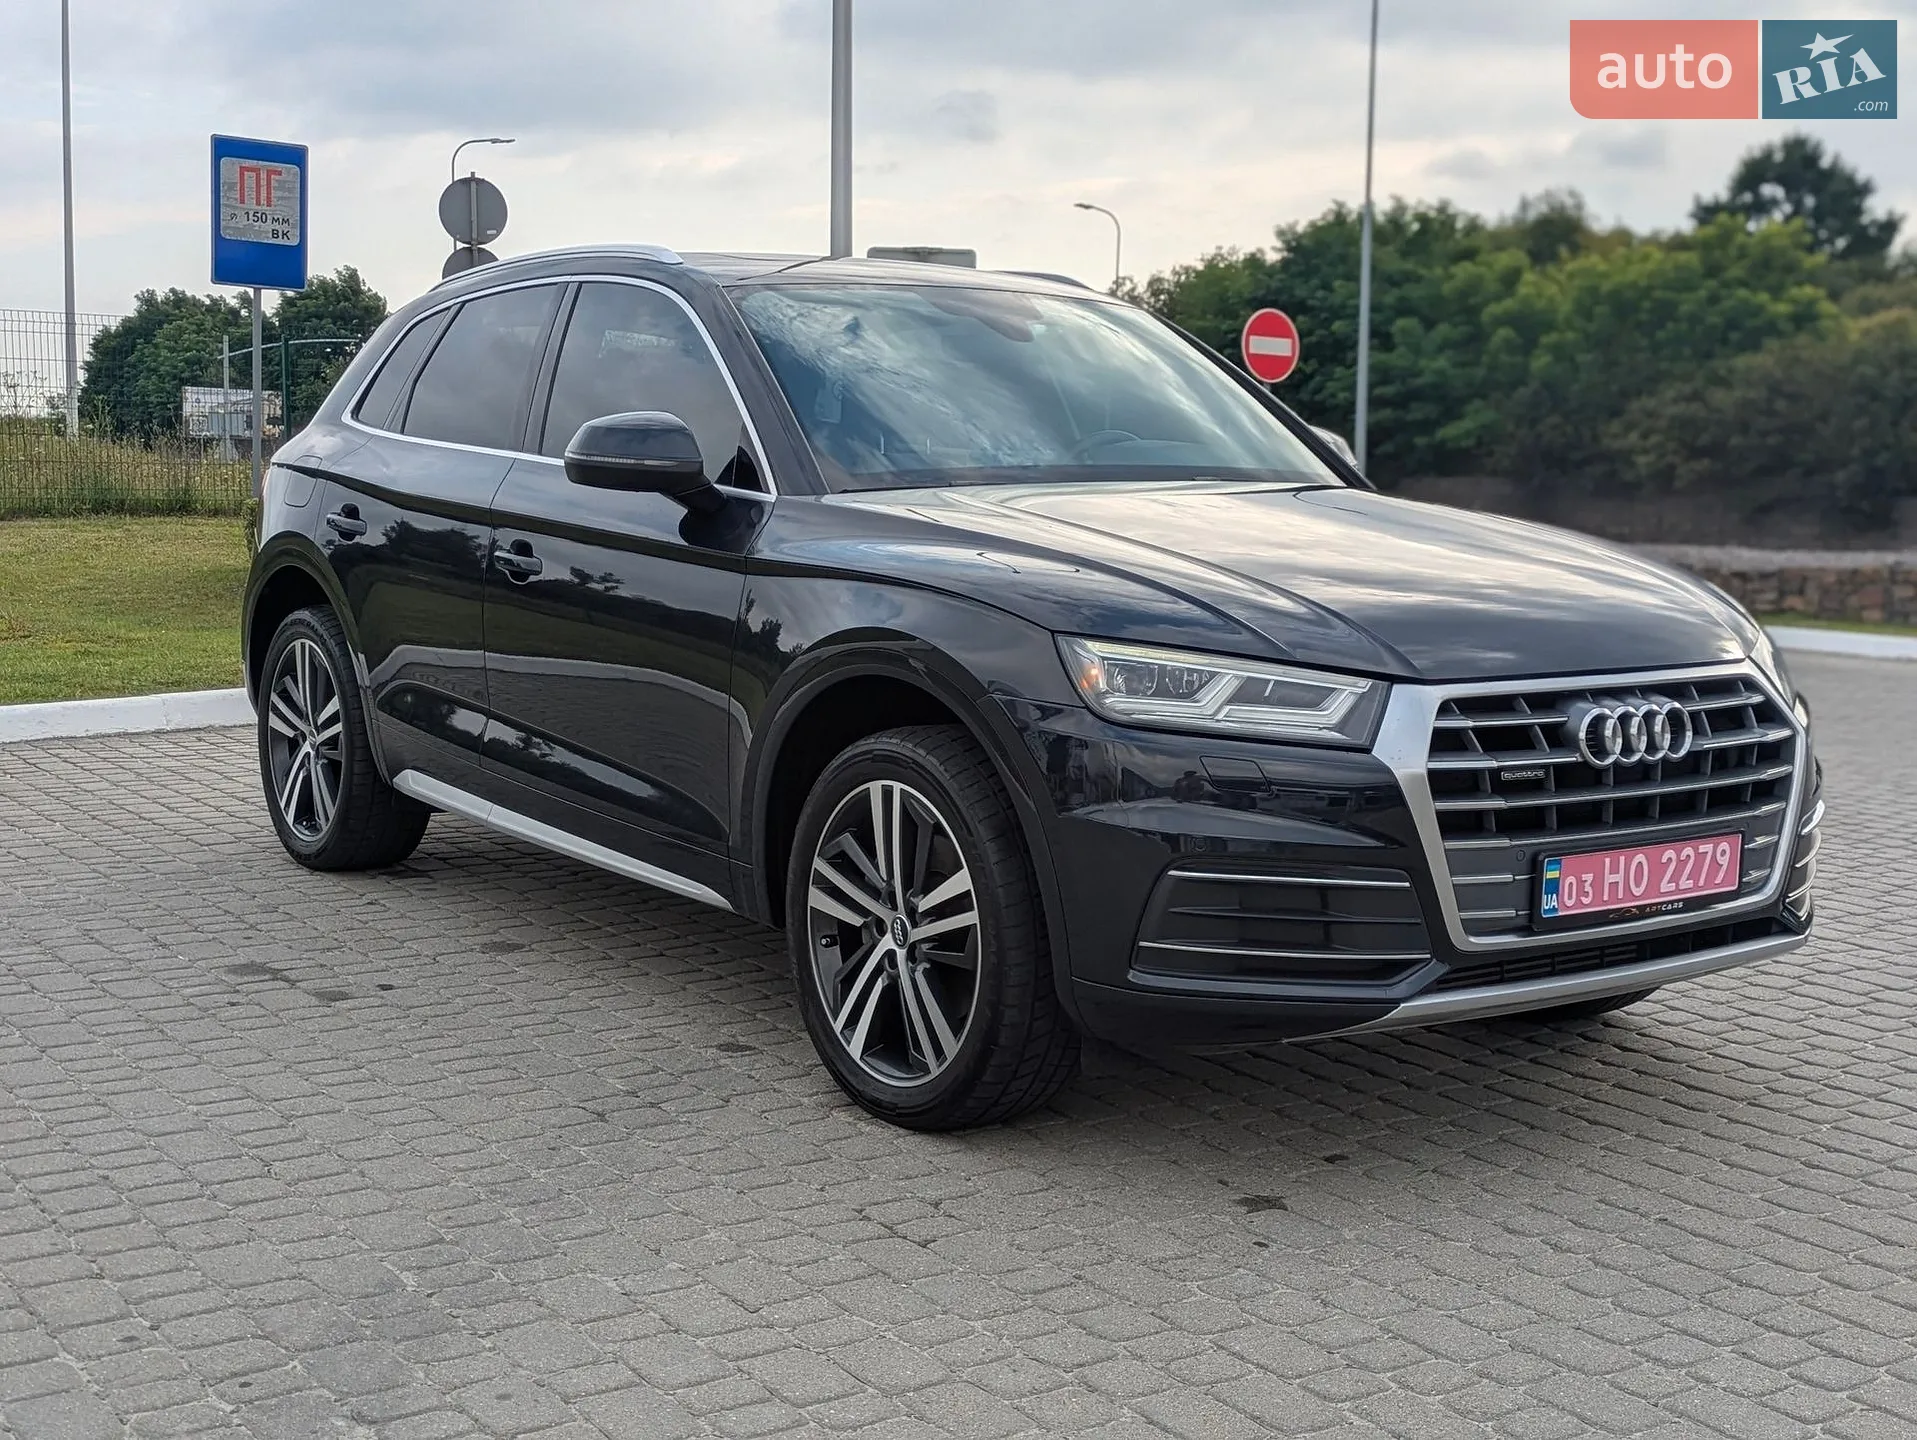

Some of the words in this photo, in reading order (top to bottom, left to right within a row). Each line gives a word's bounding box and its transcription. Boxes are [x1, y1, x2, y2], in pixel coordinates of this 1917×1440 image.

[238, 165, 283, 208] ПГ
[244, 211, 268, 224] 150
[1504, 771, 1544, 779] quattro
[1563, 873, 1594, 907] 03
[1603, 853, 1649, 901] HO
[1660, 842, 1731, 893] 2279
[1543, 893, 1559, 910] UA
